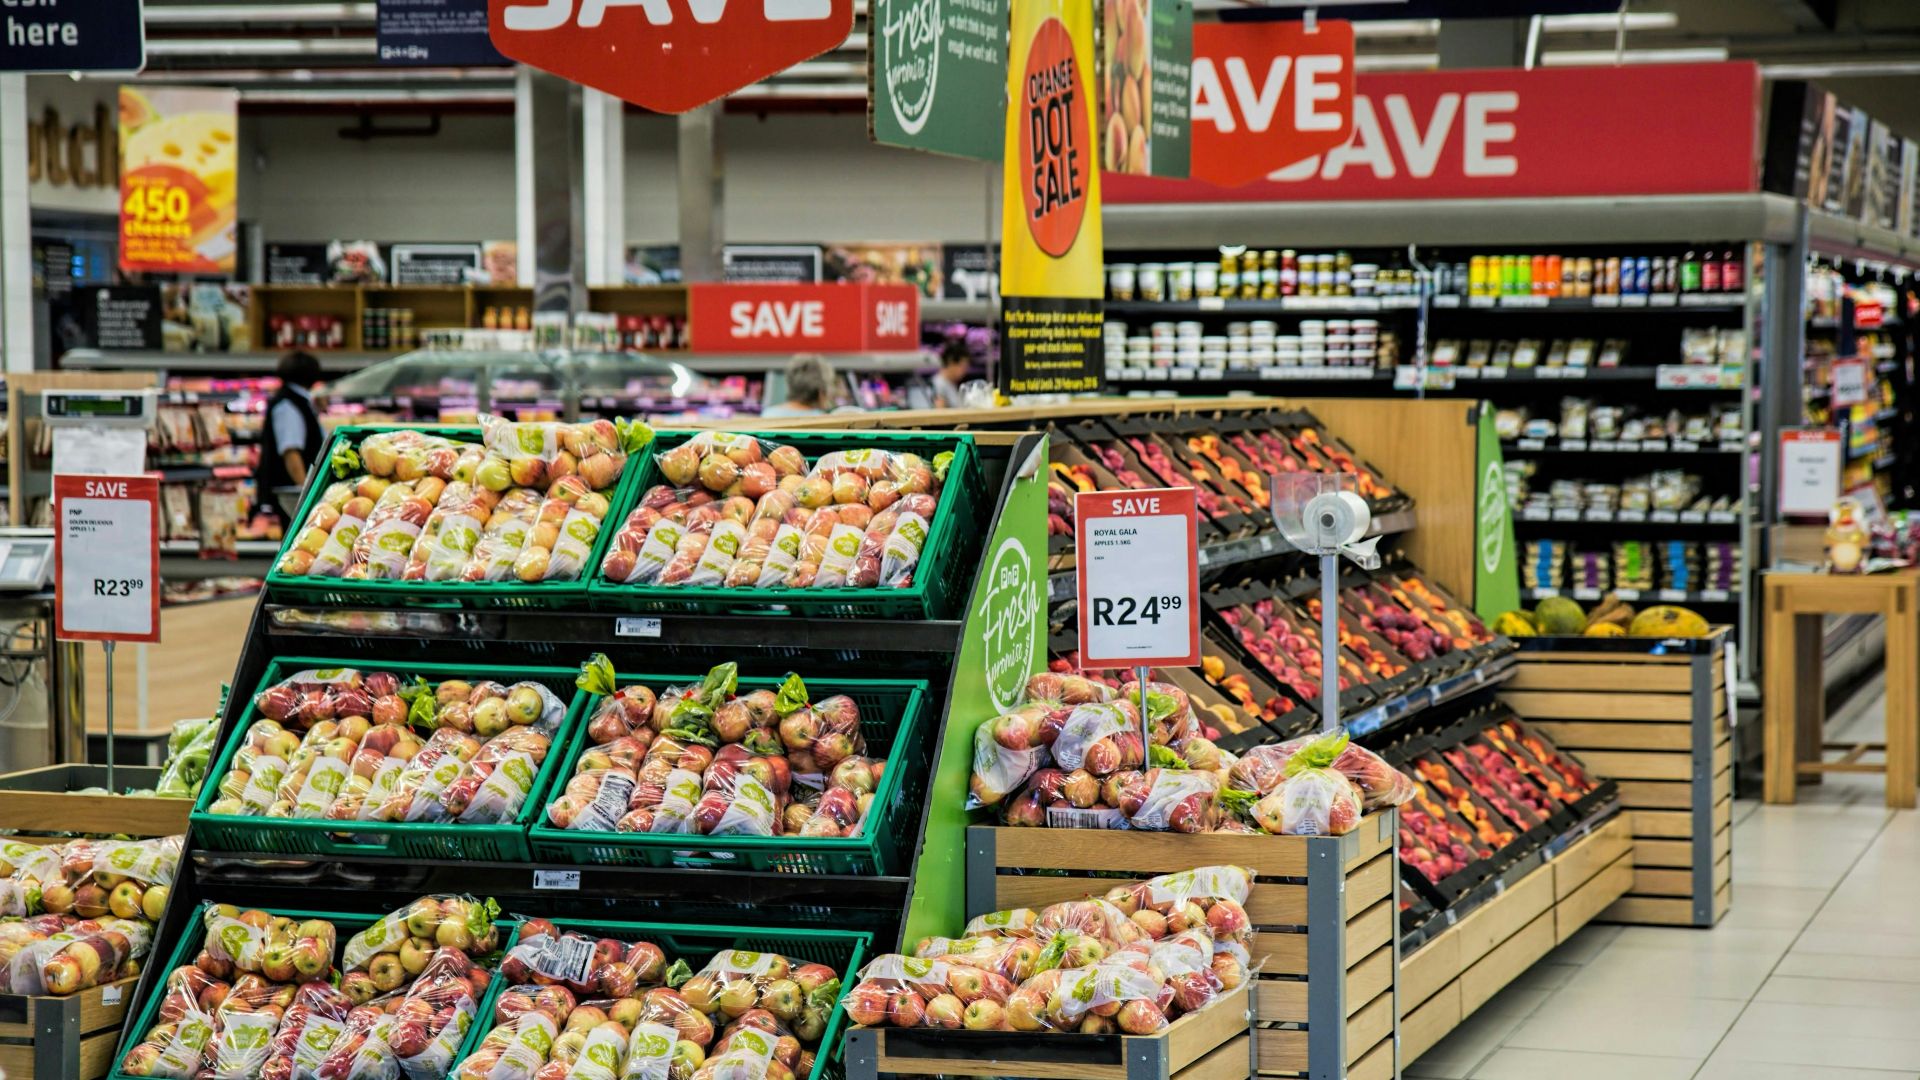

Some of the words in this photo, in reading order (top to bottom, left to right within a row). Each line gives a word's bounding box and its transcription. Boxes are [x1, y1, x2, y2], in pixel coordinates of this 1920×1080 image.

[7, 15, 79, 46] here
[1028, 58, 1073, 105] ORANGE
[1030, 90, 1073, 167] DOT
[1265, 91, 1520, 181] AVE
[1033, 151, 1082, 220] SALE
[124, 186, 190, 222] 450
[730, 301, 825, 337] SAVE
[875, 301, 909, 337] SAVE
[85, 481, 128, 498] SAVE
[1112, 498, 1161, 515] SAVE
[1094, 529, 1117, 537] ROYAL
[1118, 528, 1138, 536] GALA
[1001, 564, 1020, 590] PnP
[979, 555, 1041, 653] Fresh
[991, 643, 1022, 682] promise
